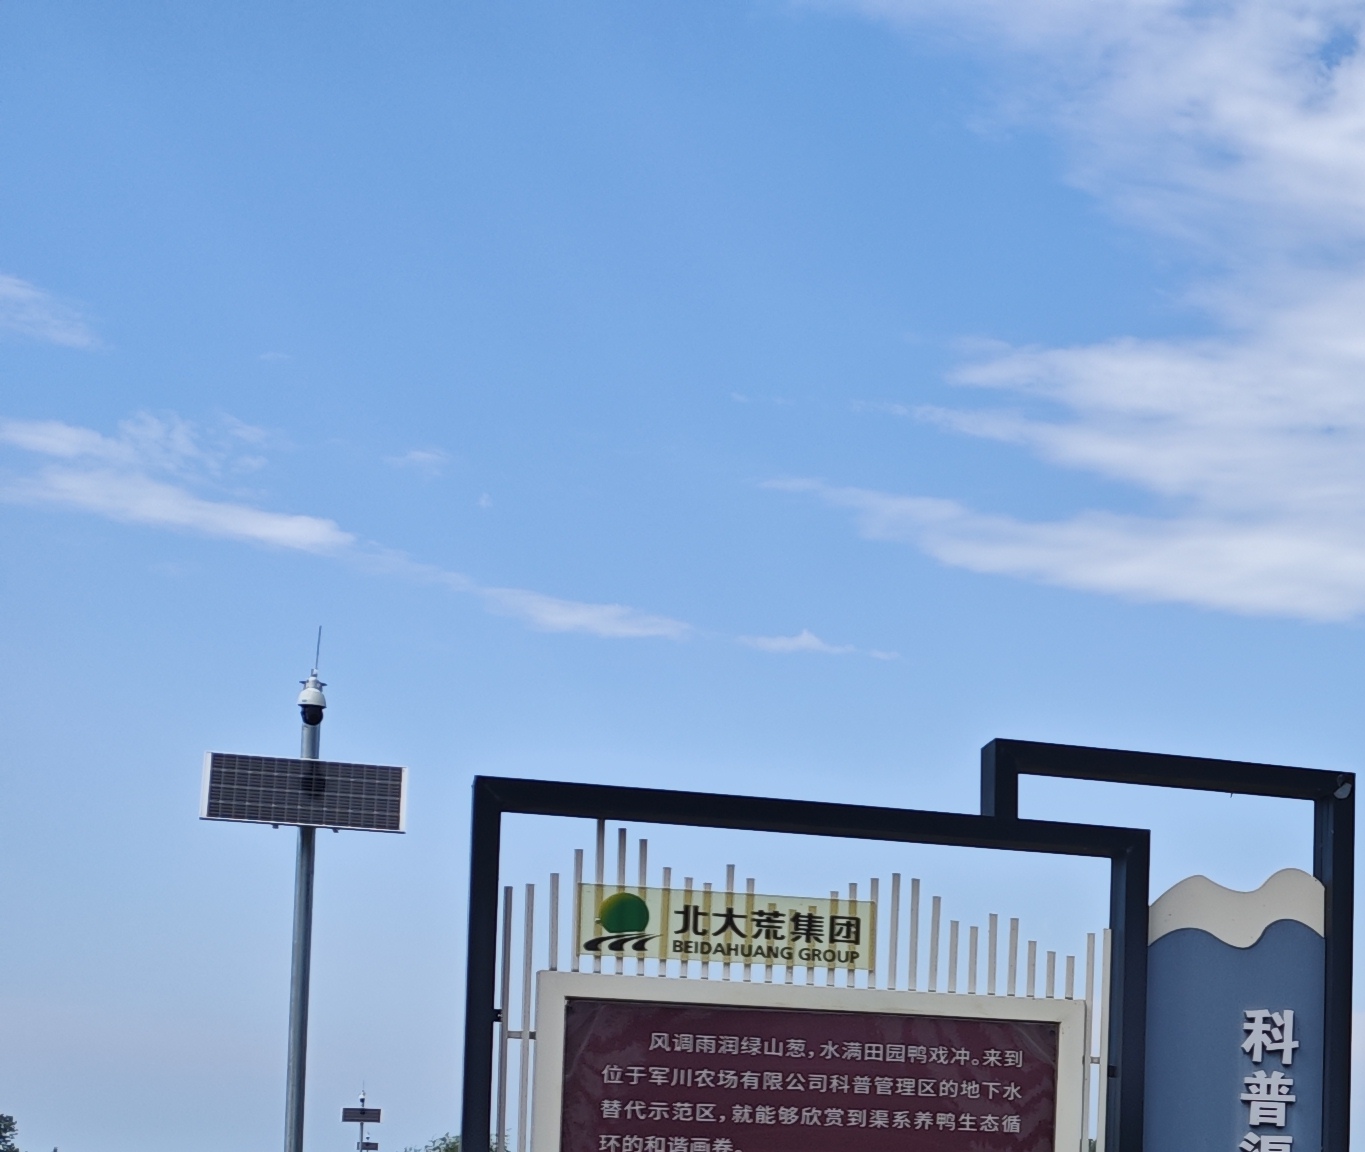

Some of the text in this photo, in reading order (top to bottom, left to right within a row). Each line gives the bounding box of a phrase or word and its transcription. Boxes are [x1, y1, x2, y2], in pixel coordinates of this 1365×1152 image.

[673, 904, 861, 945] 北大荒集团
[672, 939, 860, 963] BEIDAHUANG GROUP
[601, 1064, 1023, 1101] 位于军川农场有限公司科普管理区的地下水
[600, 1099, 1021, 1134] 替代示范区，就能够欣赏到渠系养鸭生态循
